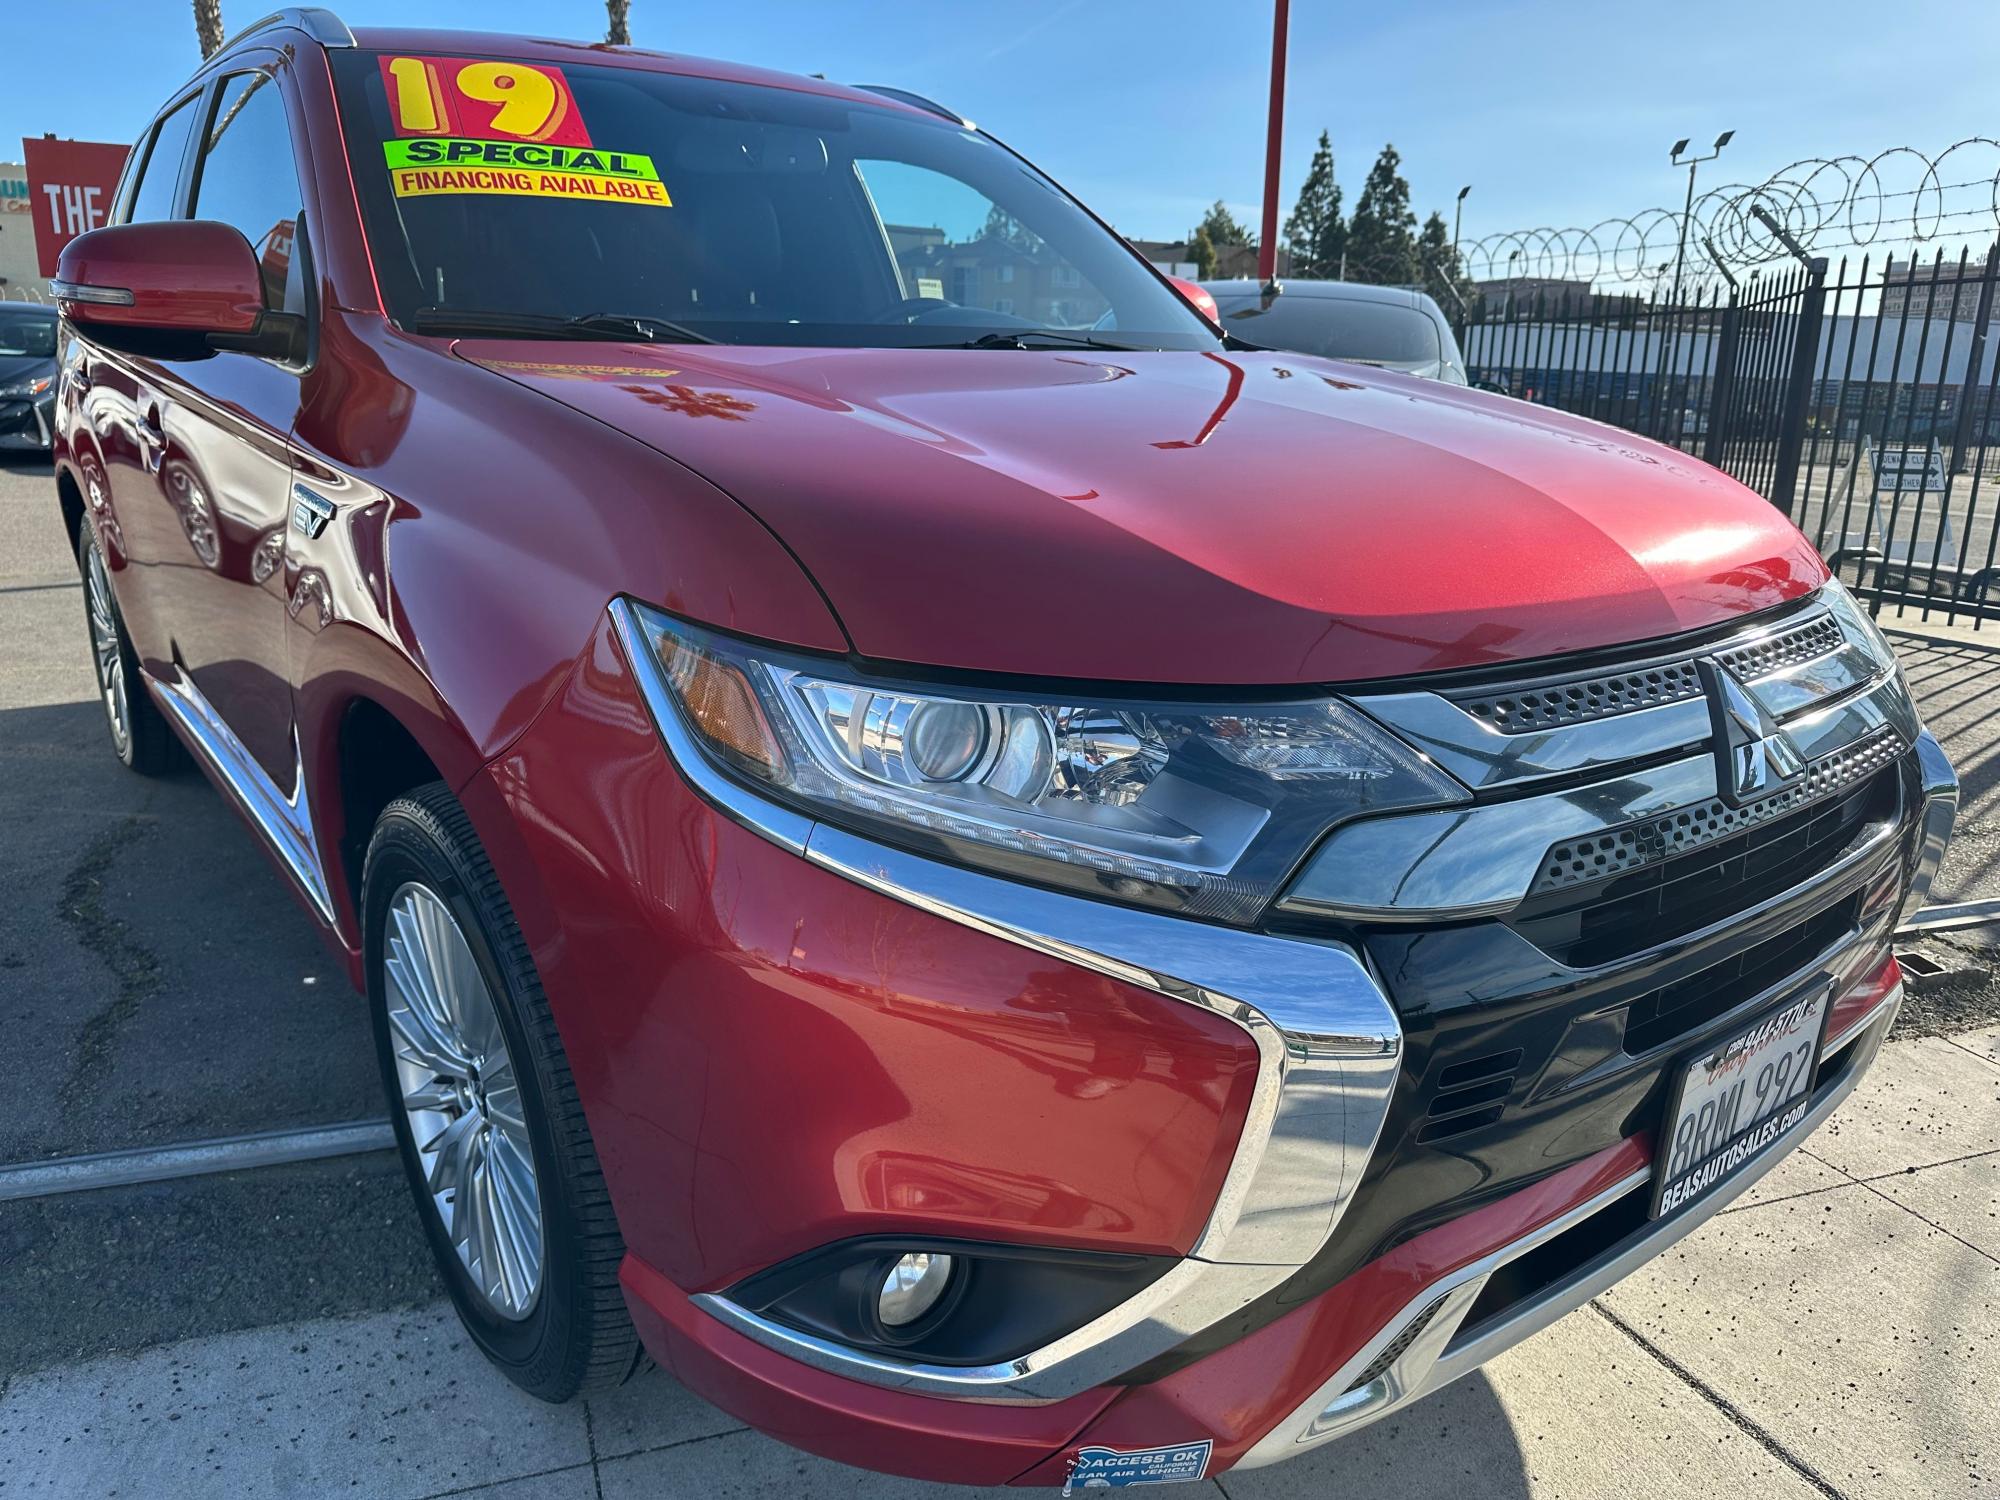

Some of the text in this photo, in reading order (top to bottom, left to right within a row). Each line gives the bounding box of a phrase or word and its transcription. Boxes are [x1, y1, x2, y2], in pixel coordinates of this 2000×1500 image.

[388, 57, 568, 141] 19
[407, 141, 640, 175] SPECIAL
[400, 171, 664, 202] FINANCING AVAILABLE
[1911, 455, 1939, 464] CLOED
[1900, 479, 1920, 488] THER
[1744, 999, 1808, 1051] 944-5770
[1660, 1101, 1807, 1217] BEASAUTOSALES.com
[1091, 1455, 1164, 1467] ACCESS
[1172, 1450, 1200, 1462] OK
[1148, 1460, 1198, 1470] CALIFORNIA
[1067, 1472, 1107, 1480] LEAN
[1140, 1465, 1197, 1476] VEHICLE
